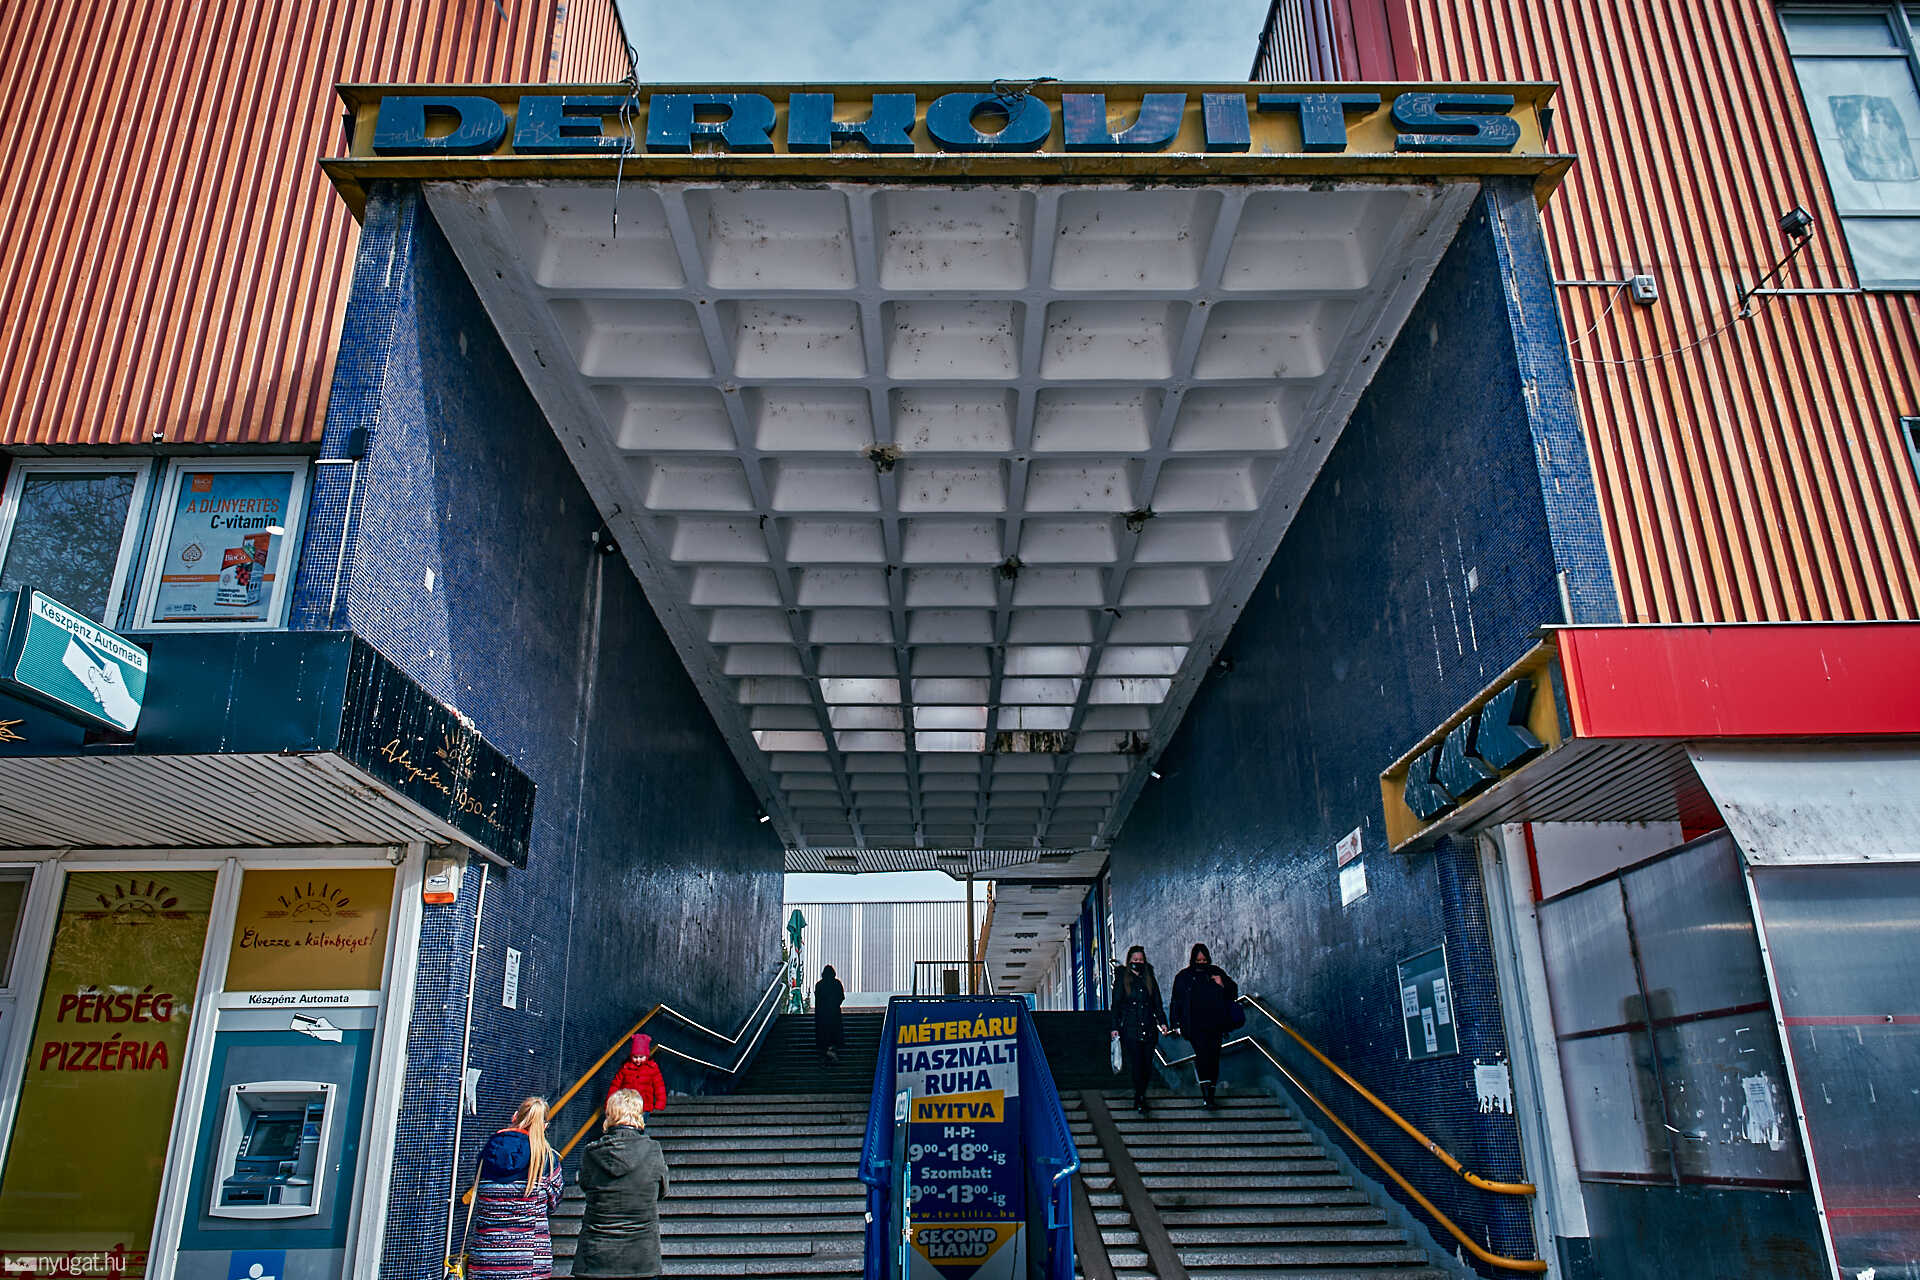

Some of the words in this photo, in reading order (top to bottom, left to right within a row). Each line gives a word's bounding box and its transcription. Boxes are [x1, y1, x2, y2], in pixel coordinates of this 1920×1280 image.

[373, 92, 1521, 155] DERKOVITS
[187, 500, 196, 513] A
[200, 496, 280, 513] DÍJNYERTES
[210, 514, 277, 529] C-vitamin
[41, 600, 92, 640] Készpénz
[94, 631, 142, 667] Automata
[57, 984, 173, 1023] PÉKSÉG
[248, 994, 296, 1005] Készpénz
[299, 994, 350, 1004] Automata
[897, 1012, 1018, 1044] MÉTERÁRU
[39, 1032, 168, 1071] PIZZÉRIA
[897, 1041, 1018, 1073] HASZNÁLT
[925, 1069, 993, 1096] RUHA
[918, 1102, 995, 1119] NYITVA
[943, 1126, 976, 1139] H-P:
[921, 1166, 993, 1179] Szombat:
[918, 1227, 998, 1244] SECOND
[928, 1242, 989, 1258] HAND
